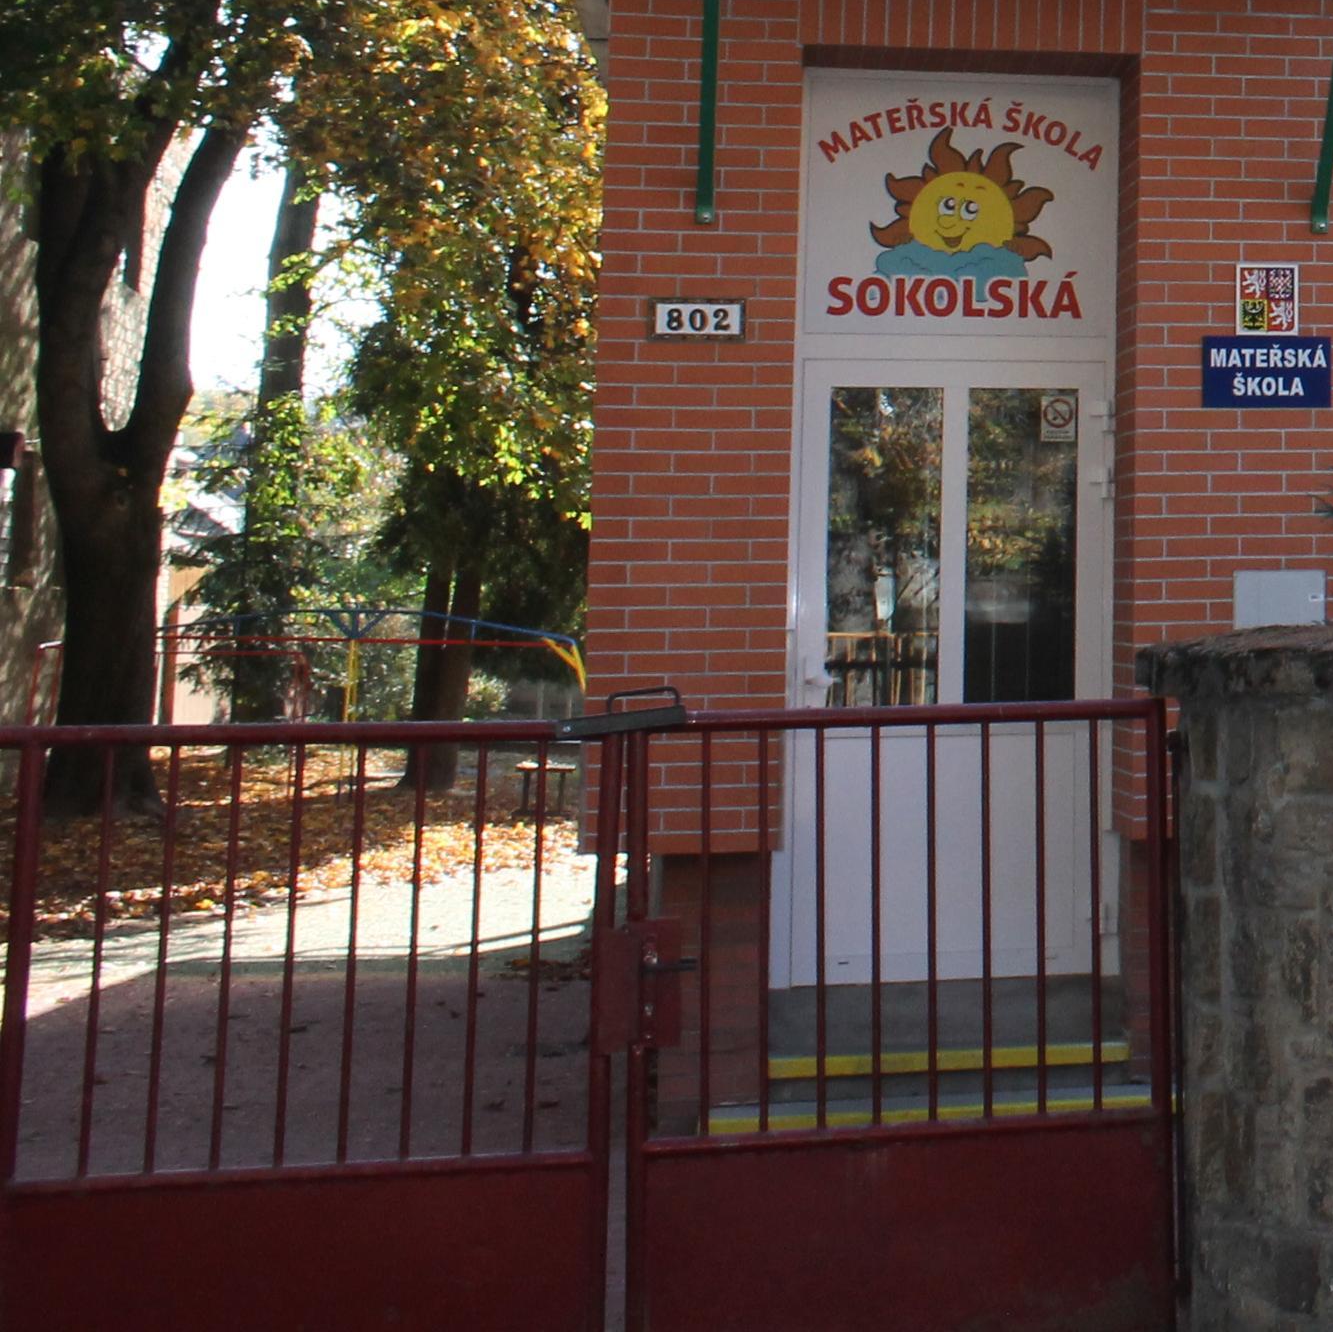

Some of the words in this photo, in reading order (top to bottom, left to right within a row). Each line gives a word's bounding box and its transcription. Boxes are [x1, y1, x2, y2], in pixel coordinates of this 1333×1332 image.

[817, 97, 993, 164] MATEŘSKÁ
[1001, 100, 1104, 171] ŠKOLA
[826, 271, 1083, 319] SOKOLSKÁ
[666, 308, 731, 331] 802
[1210, 344, 1327, 368] MATEŘSKÁ
[1232, 372, 1305, 396] ŠKOLA
